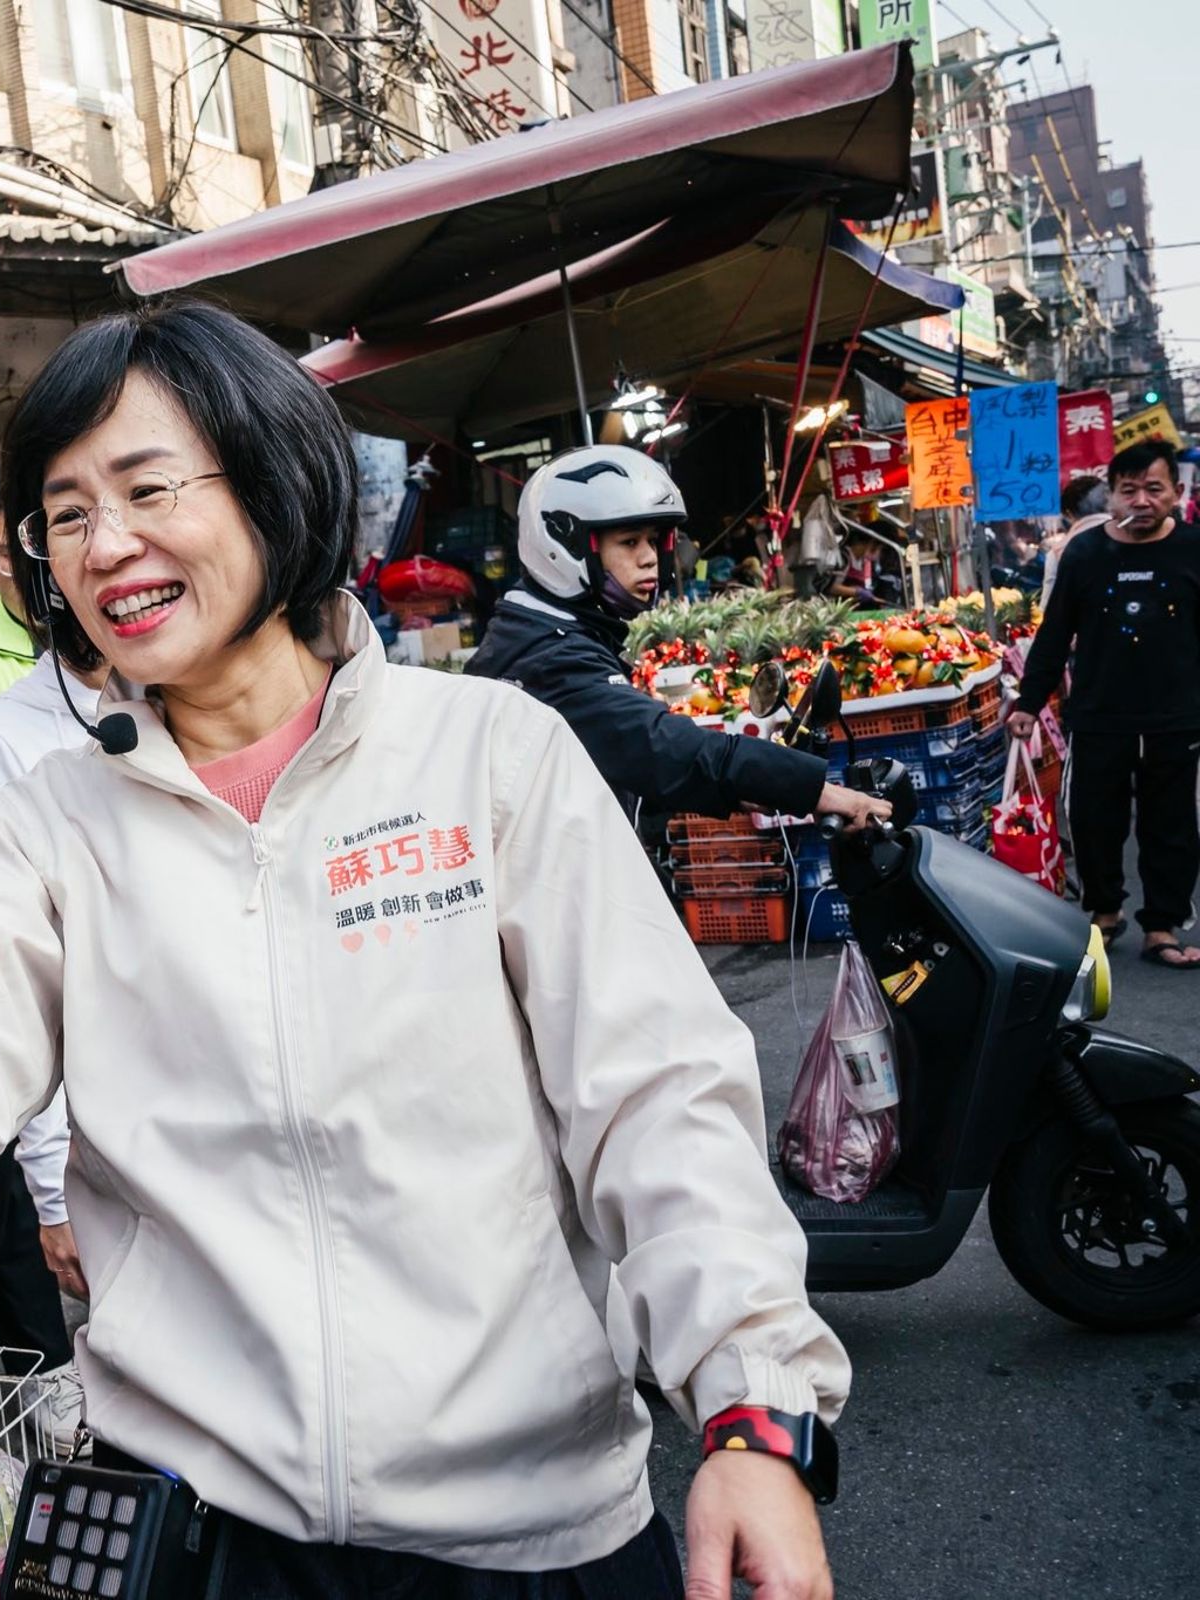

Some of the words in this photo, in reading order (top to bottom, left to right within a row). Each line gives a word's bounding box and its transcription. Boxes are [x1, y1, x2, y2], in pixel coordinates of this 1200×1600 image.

[342, 811, 427, 846] 新北市長候選人
[325, 824, 476, 897] 蘇巧慧
[335, 900, 377, 929] 溫暖
[380, 893, 422, 917] 創新
[424, 878, 485, 911] 會做事
